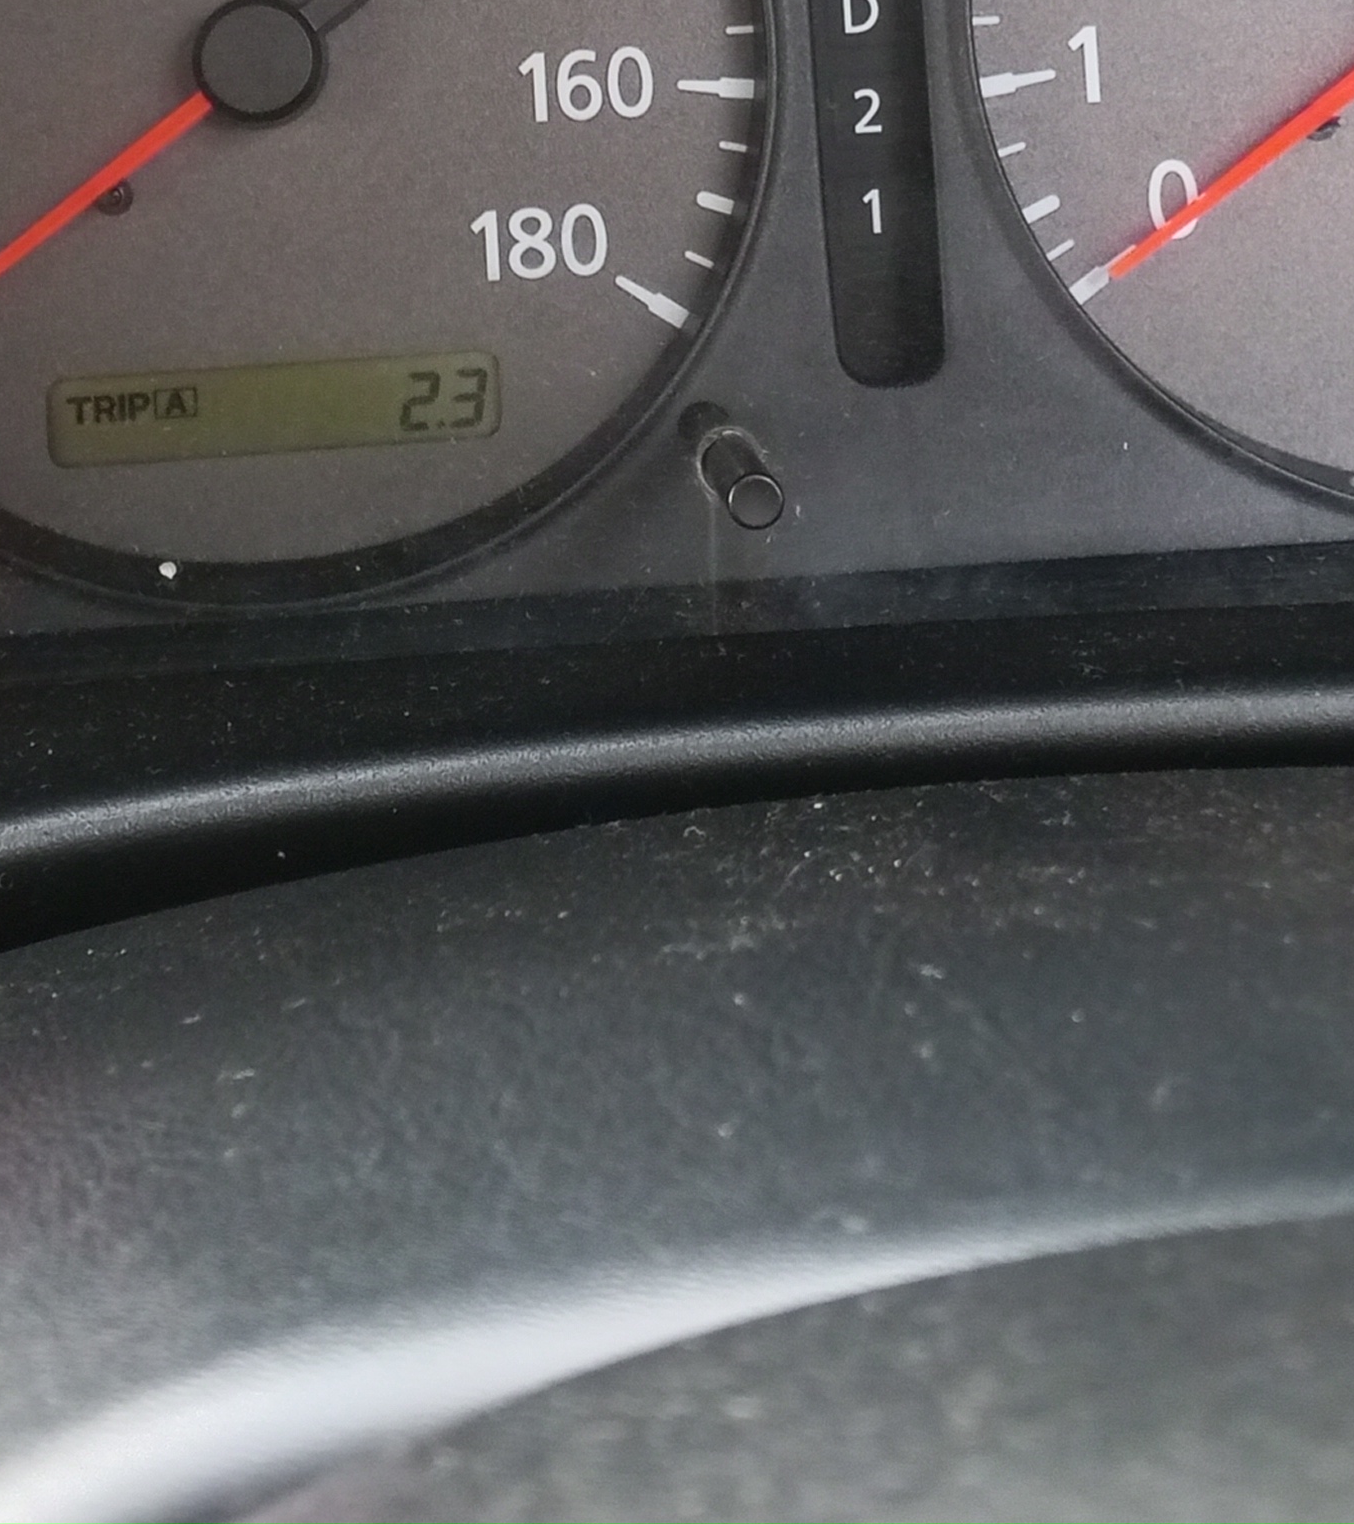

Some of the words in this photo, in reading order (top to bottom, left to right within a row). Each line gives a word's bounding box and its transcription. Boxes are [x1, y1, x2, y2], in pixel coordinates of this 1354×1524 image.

[518, 46, 654, 122] 160
[1066, 25, 1102, 104] 1
[853, 88, 883, 134] 2
[861, 188, 883, 234] 1
[1147, 159, 1199, 241] 0
[470, 204, 608, 282] 180
[66, 394, 149, 425] TRIP
[399, 367, 489, 432] 2.3
